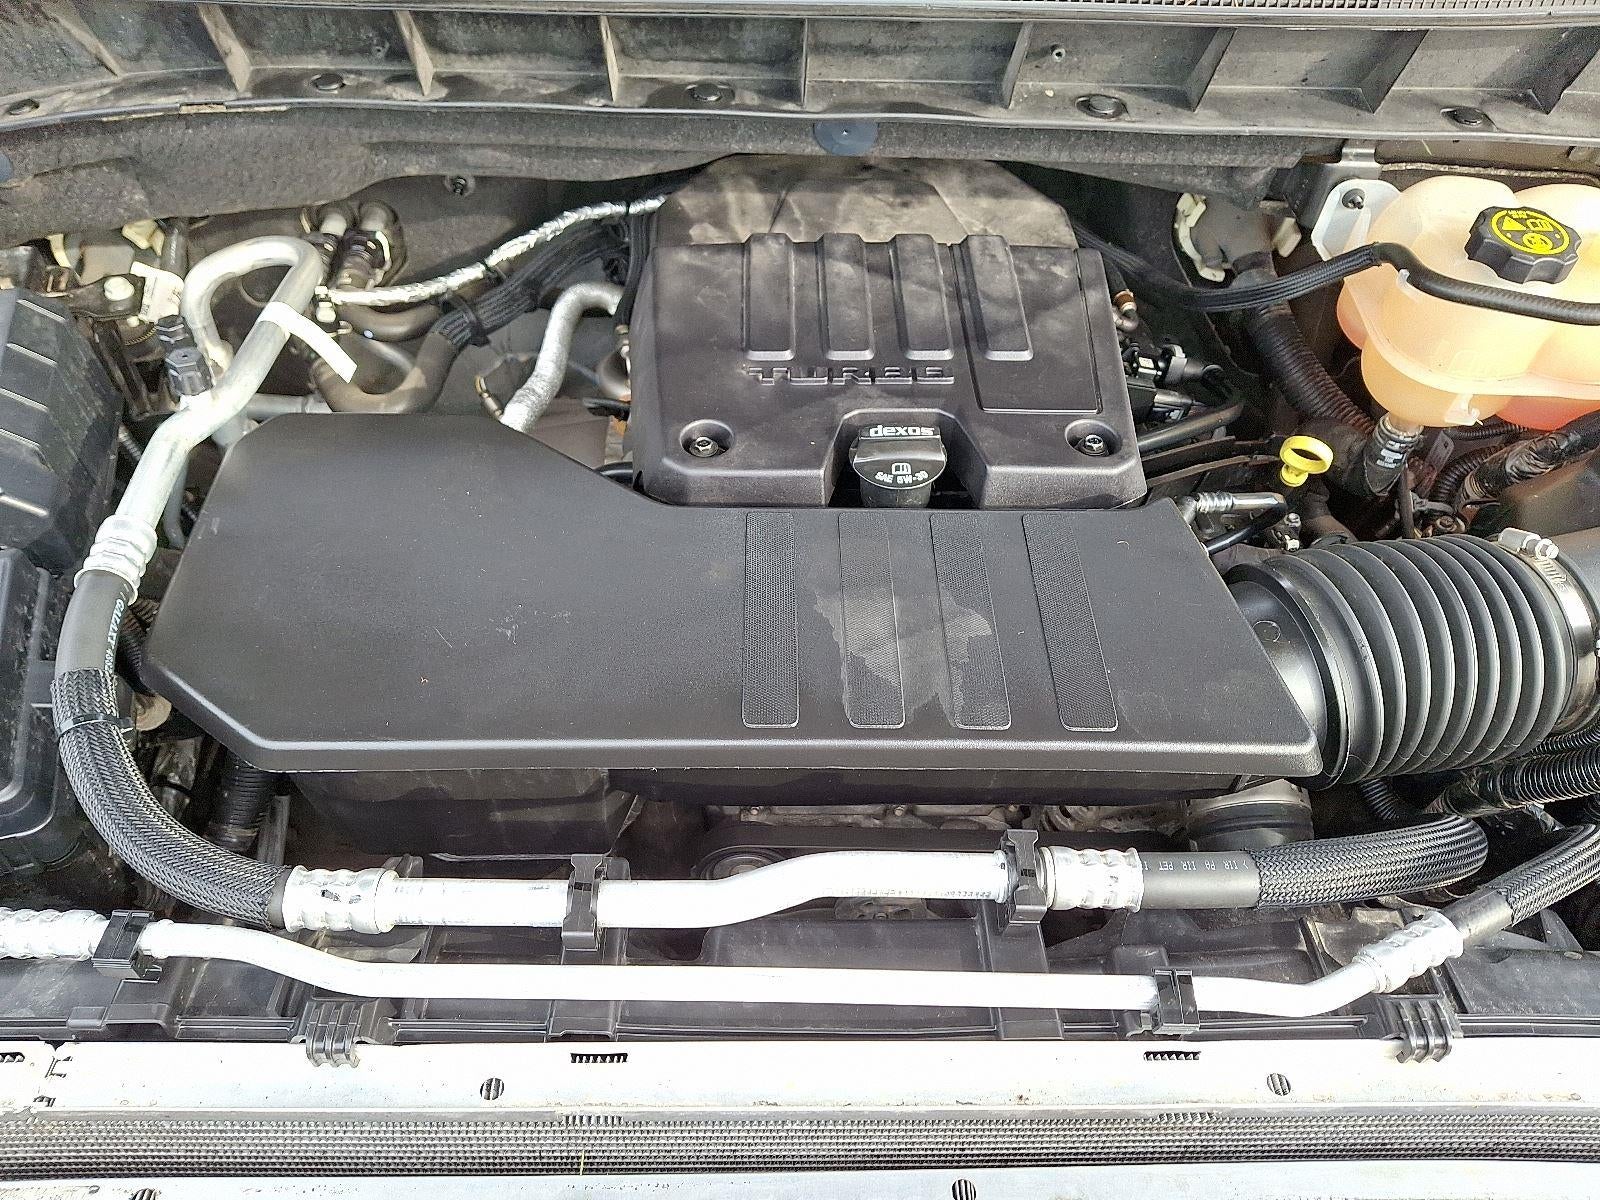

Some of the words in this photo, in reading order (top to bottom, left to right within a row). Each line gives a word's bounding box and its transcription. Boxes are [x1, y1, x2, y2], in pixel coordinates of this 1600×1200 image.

[869, 424, 935, 437] dexos
[874, 471, 894, 484] SAE
[1158, 860, 1175, 871] PET
